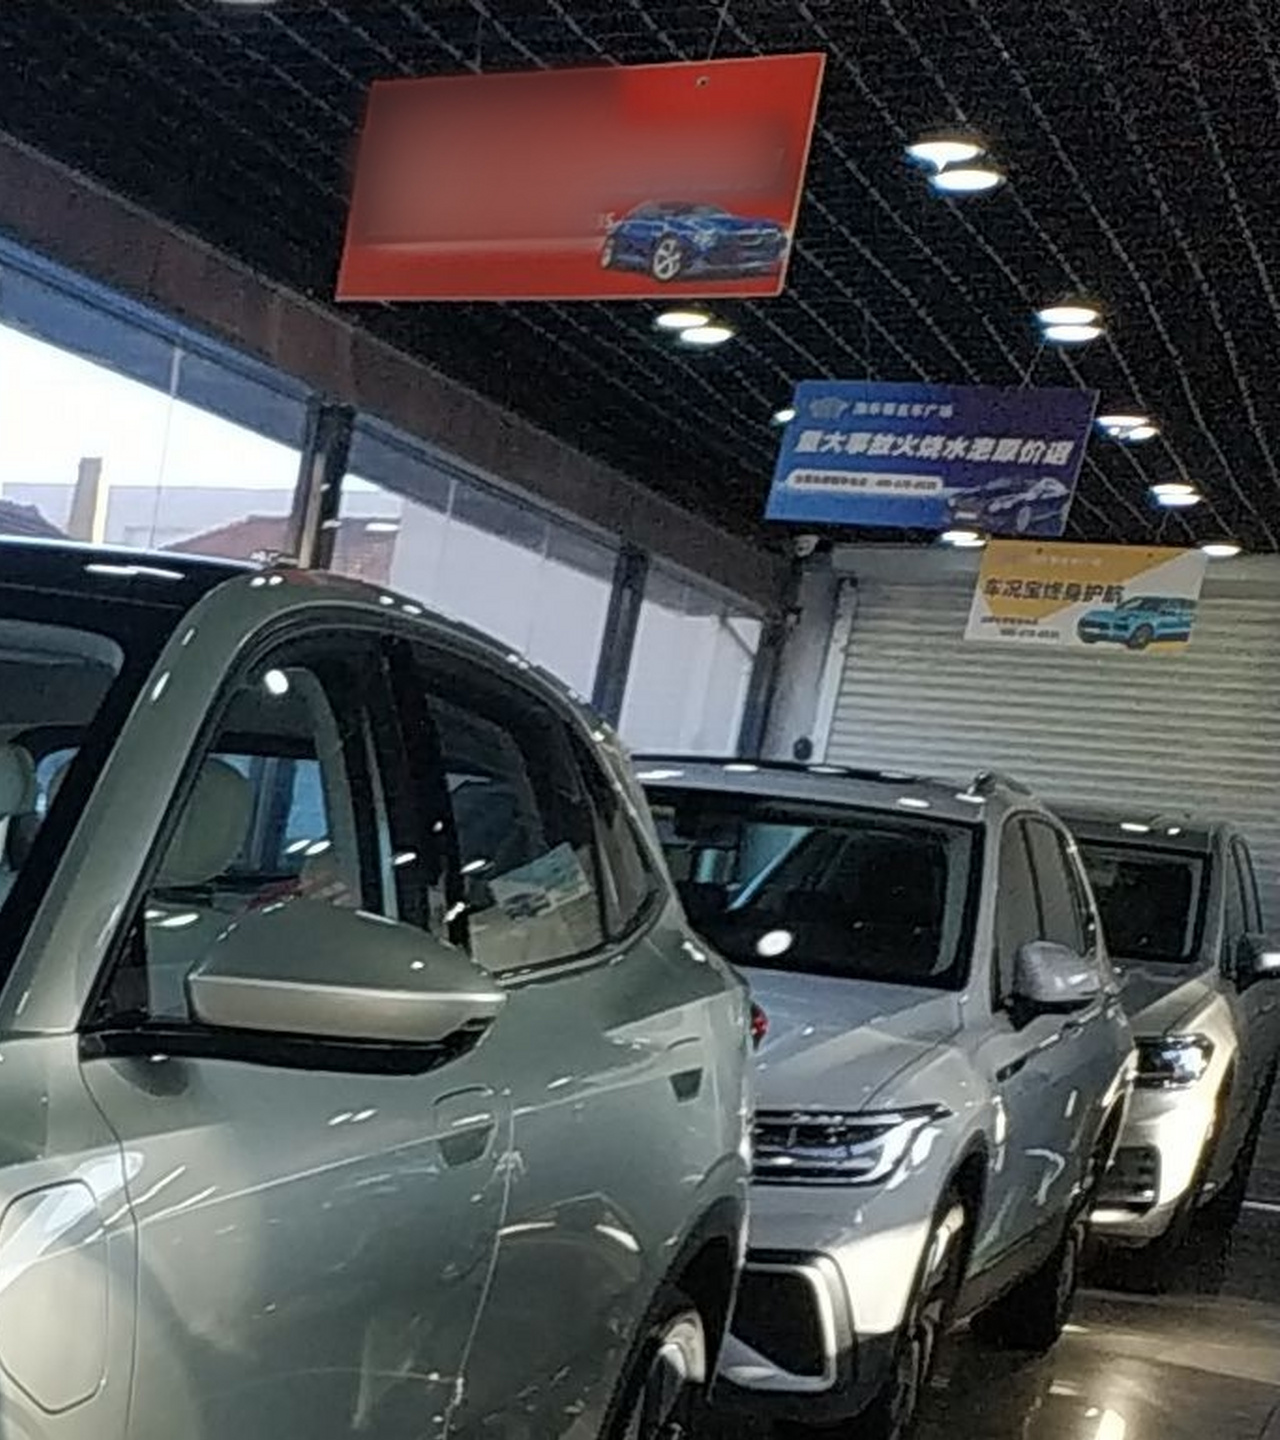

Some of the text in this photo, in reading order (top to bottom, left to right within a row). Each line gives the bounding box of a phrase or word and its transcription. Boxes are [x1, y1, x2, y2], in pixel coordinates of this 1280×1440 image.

[982, 577, 1126, 604] 车况宝终身护航
